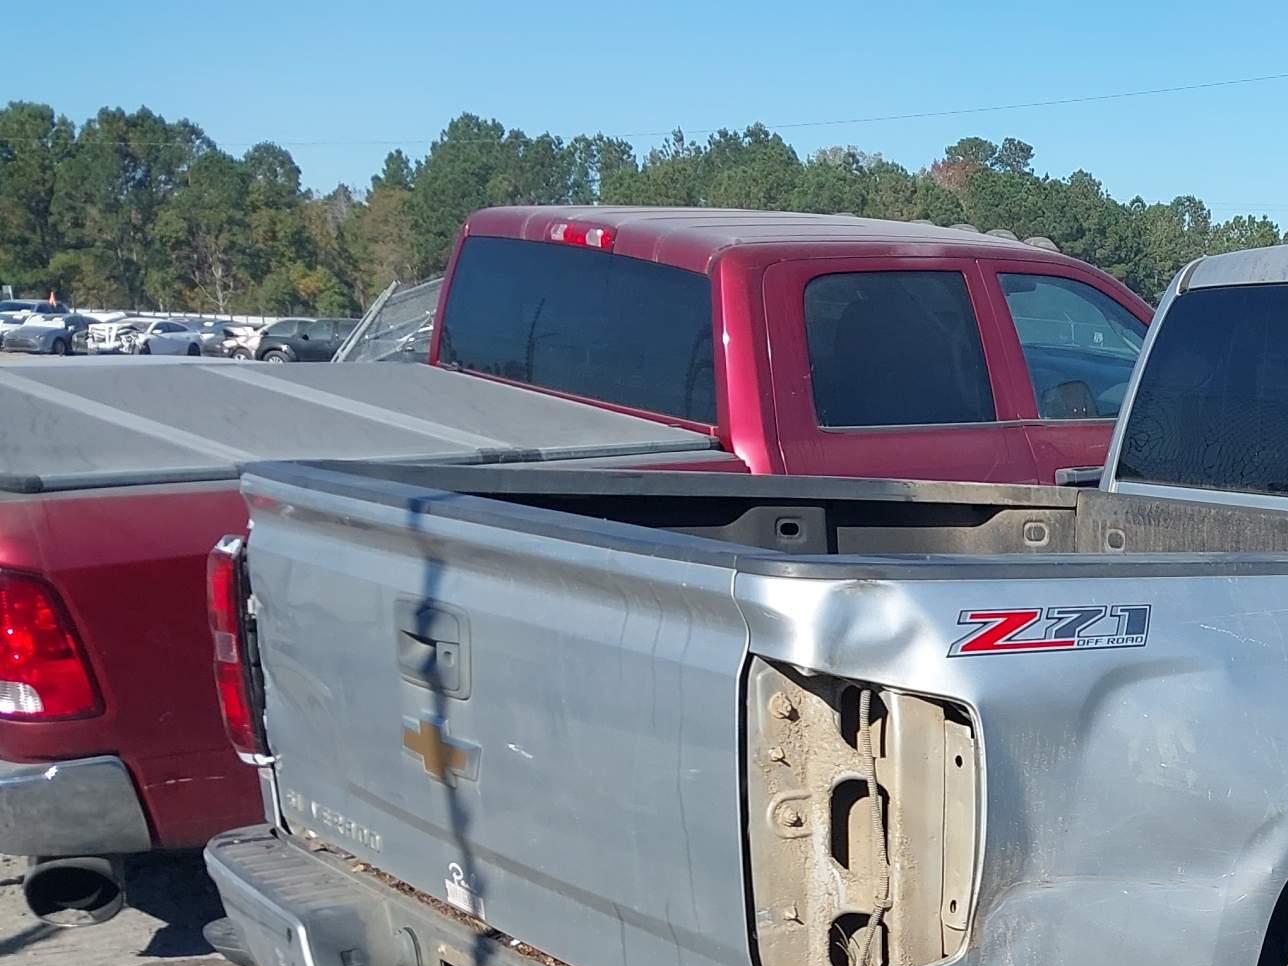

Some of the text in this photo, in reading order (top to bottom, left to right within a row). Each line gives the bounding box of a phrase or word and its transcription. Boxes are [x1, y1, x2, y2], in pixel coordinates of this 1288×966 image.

[946, 604, 1151, 658] Z71
[1076, 636, 1144, 647] OFF ROAD
[287, 790, 383, 852] SIVERADO
